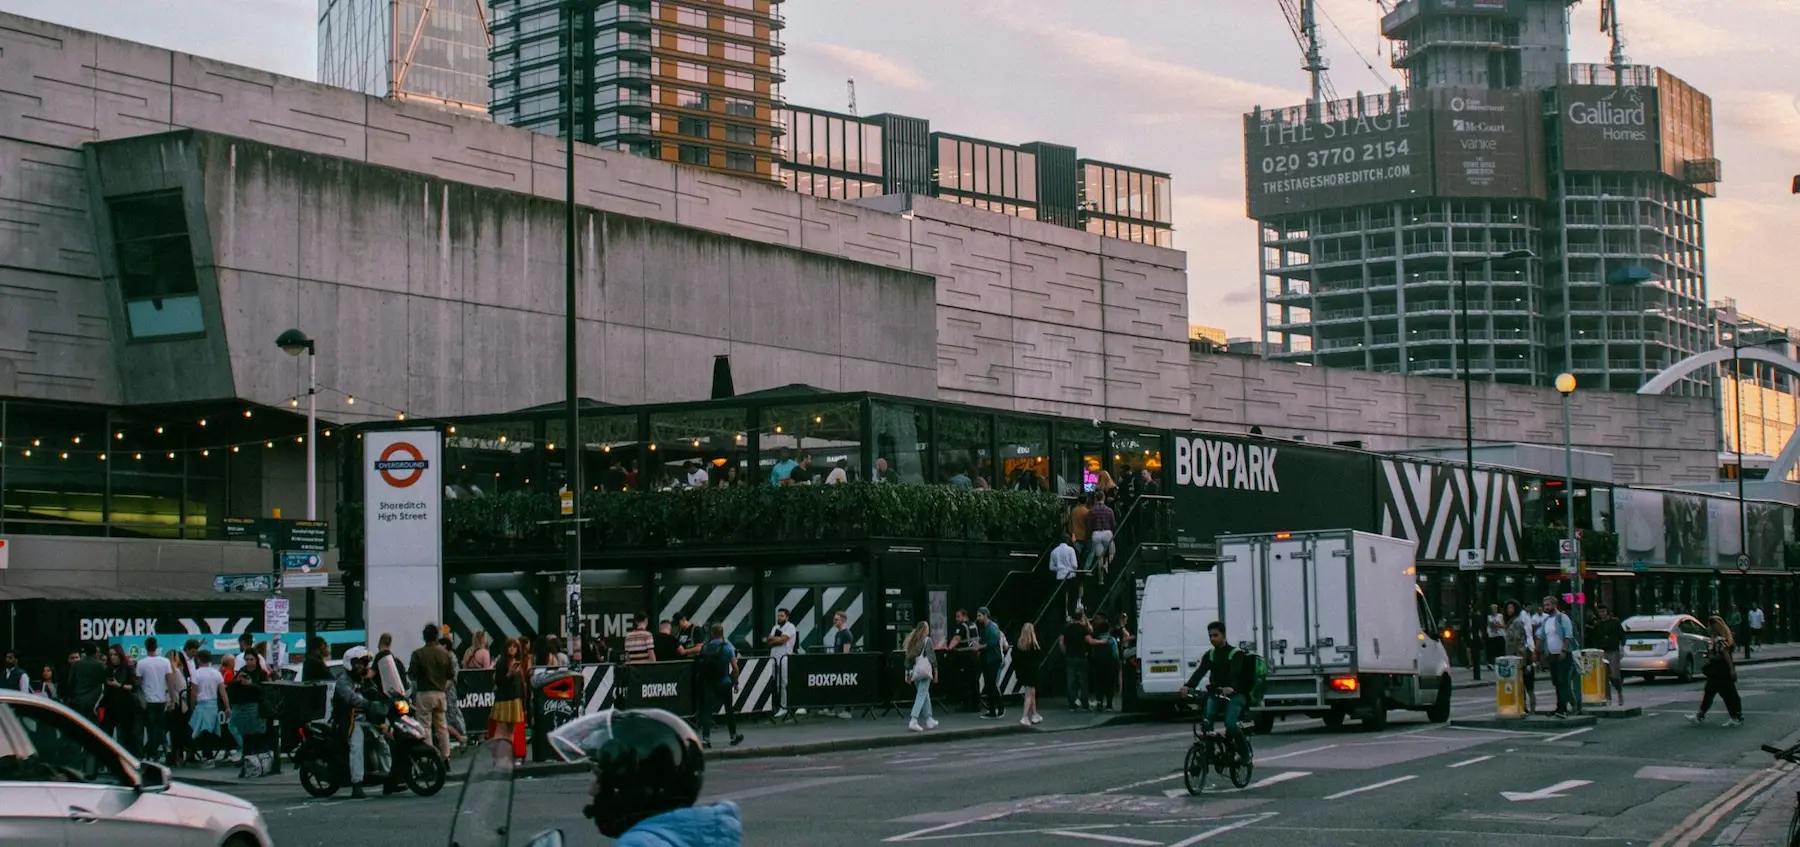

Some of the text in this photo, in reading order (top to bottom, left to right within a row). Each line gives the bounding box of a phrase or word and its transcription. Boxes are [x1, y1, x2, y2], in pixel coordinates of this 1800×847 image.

[1568, 101, 1645, 125] Galliard
[1260, 117, 1314, 147] THE
[1603, 128, 1646, 140] Homes
[1460, 139, 1497, 150] vanke
[1262, 139, 1410, 174] 020 3770 2154
[1263, 164, 1410, 194] THESTAGESHOREDITCH.COM
[1175, 436, 1279, 493] BOXPARK
[379, 501, 427, 510] Shoreditch
[378, 512, 427, 523] High Street
[1738, 558, 1748, 567] 20
[763, 570, 772, 578] 37
[79, 617, 158, 641] BOXPARK
[560, 613, 635, 638] LFT ME
[807, 672, 858, 687] BOXPARK
[641, 682, 678, 699] BOXPARK
